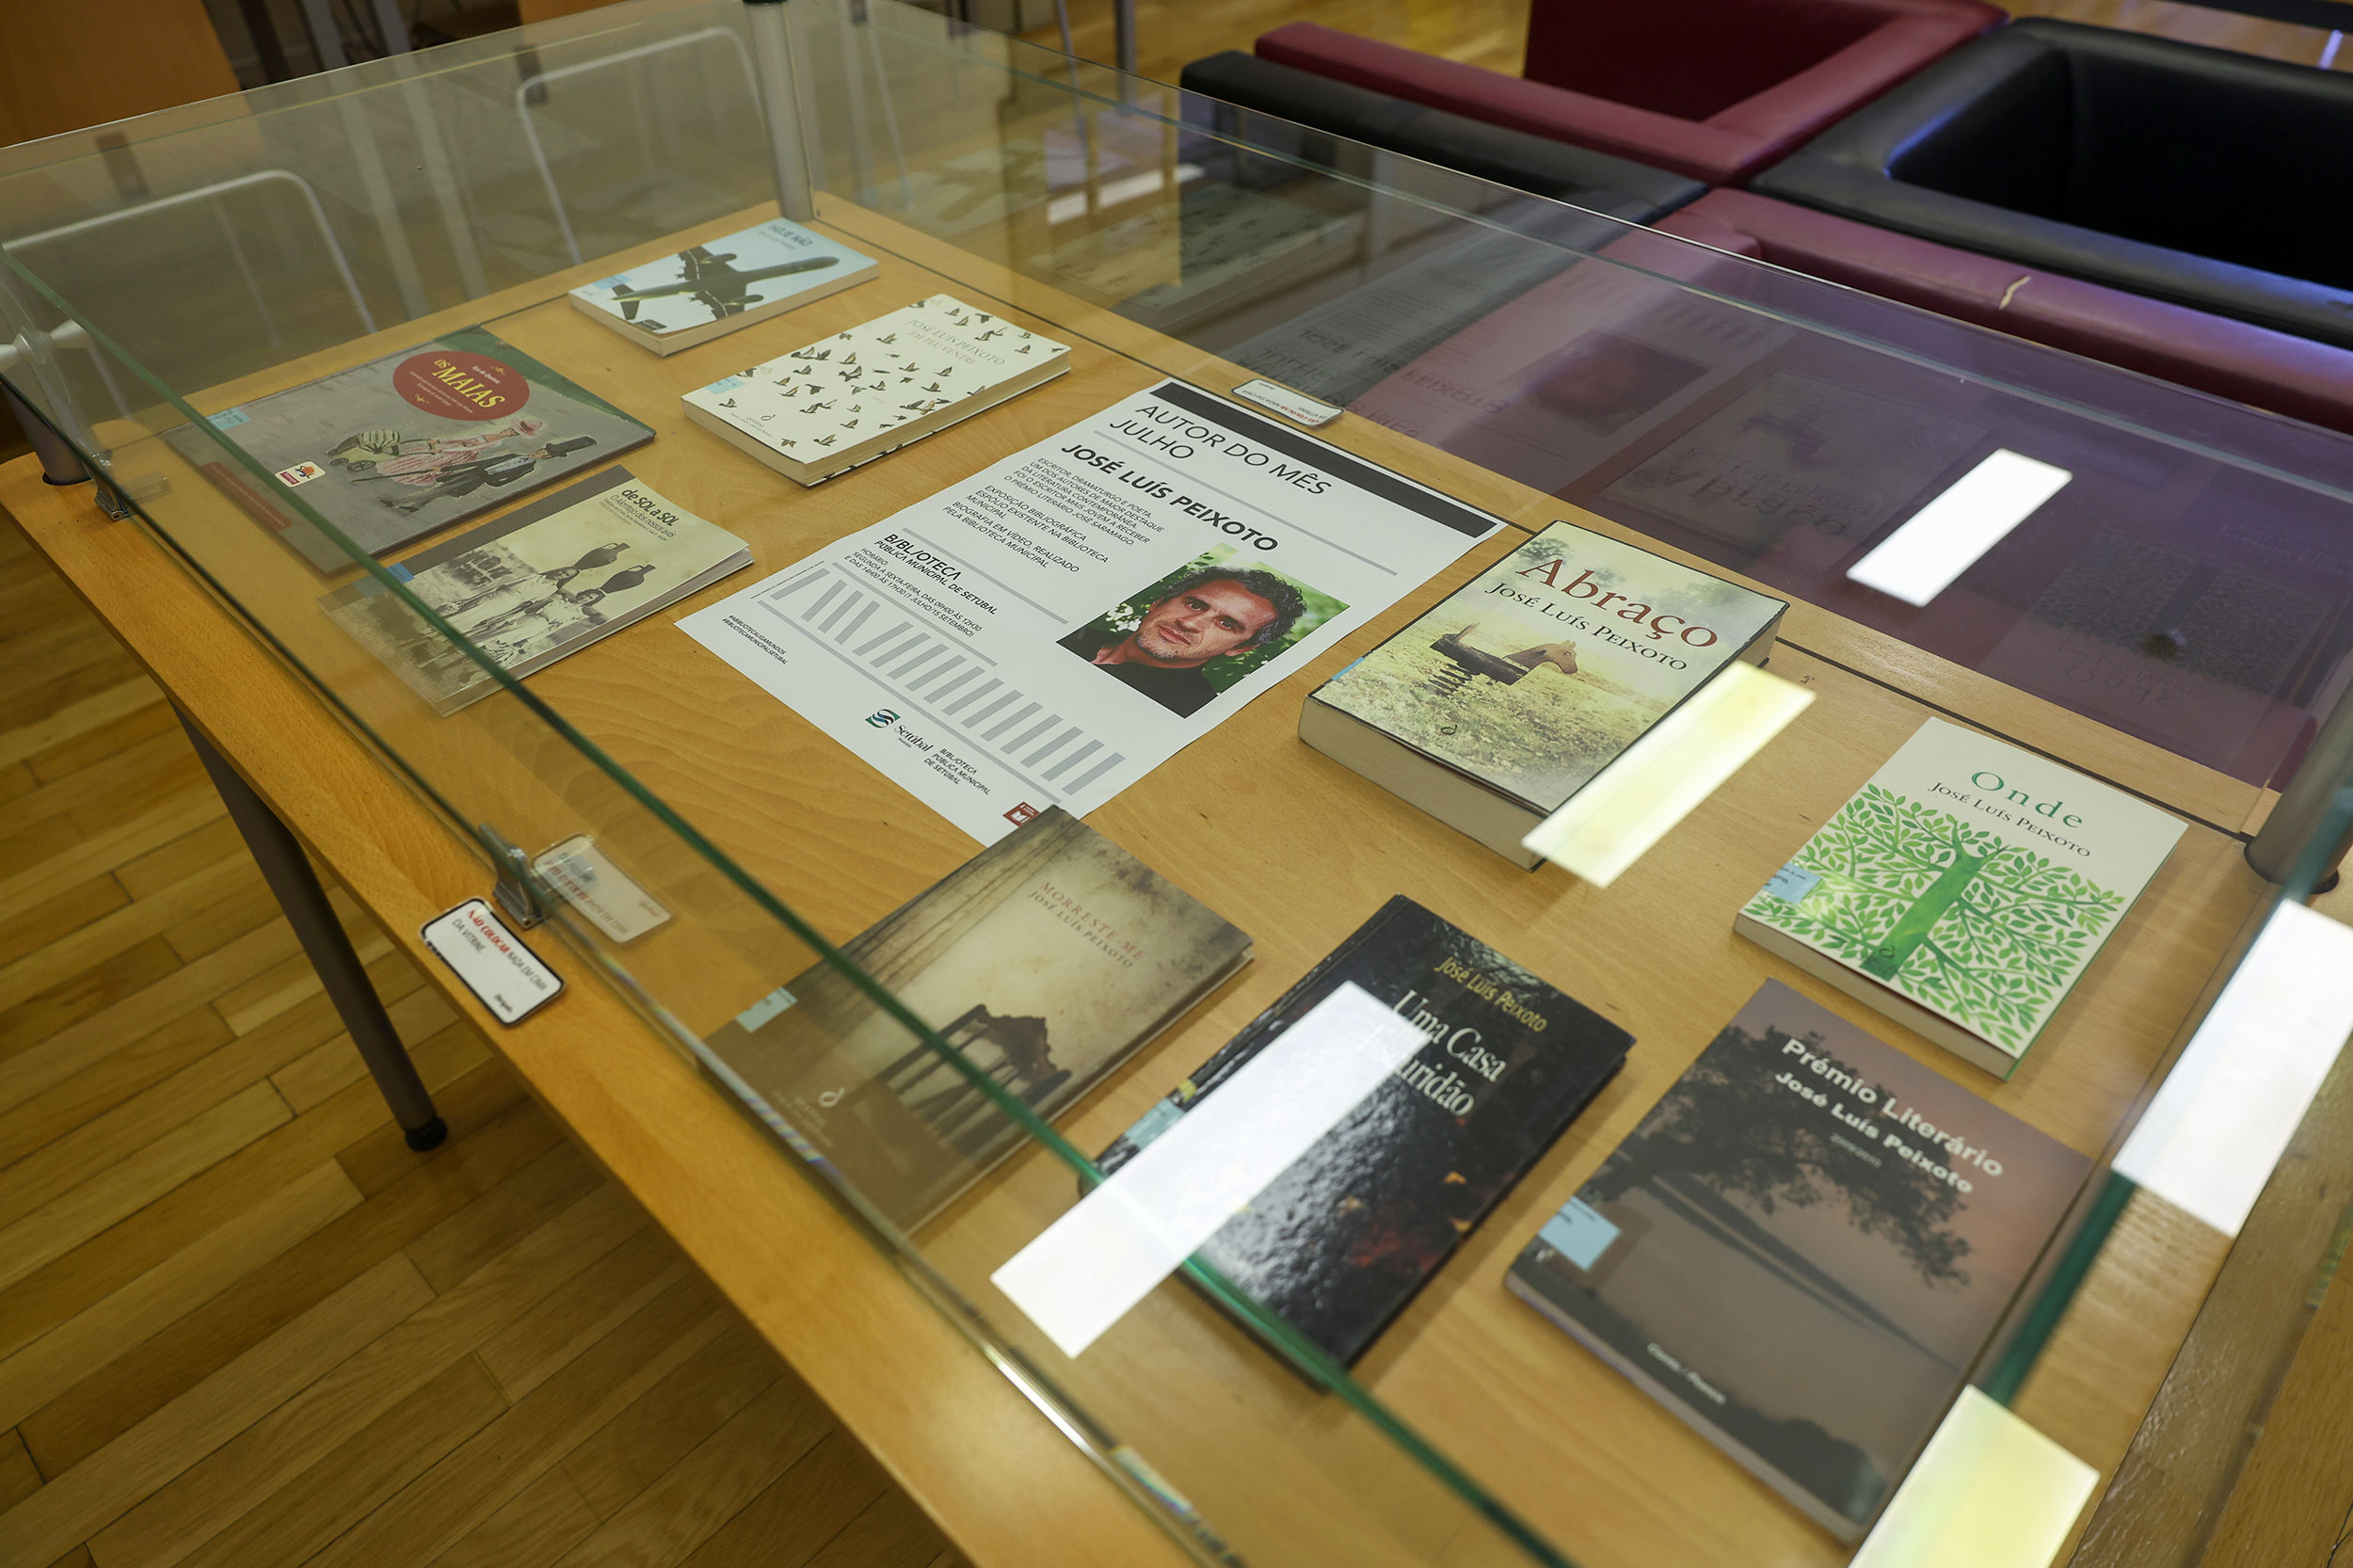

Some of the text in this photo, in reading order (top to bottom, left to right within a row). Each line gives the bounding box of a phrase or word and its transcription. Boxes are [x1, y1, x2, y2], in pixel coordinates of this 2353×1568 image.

[432, 365, 505, 408] MAIAS
[1110, 419, 1194, 459] JULHO
[1135, 406, 1332, 495] AUTOR DO MÊS
[621, 488, 680, 527] de SOL a SOL
[966, 494, 1010, 520] MUNICIPAL
[984, 485, 1087, 542] EXPOSIÇÃO BIBLIOGRÁFICA
[1011, 478, 1039, 495] PRÉMIO
[1037, 492, 1074, 514] LITERÁRIO
[1071, 511, 1091, 524] JOSÉ
[1013, 470, 1026, 478] FOI
[1032, 480, 1066, 501] ESCRITOR
[1065, 498, 1085, 510] MAIS
[1082, 508, 1112, 523] JOVEM
[1115, 523, 1151, 544] RECEBER
[1021, 465, 1034, 474] DA
[1032, 472, 1073, 495] LITERATURA
[1030, 461, 1165, 533] UM DOS AUTORES DE MAIOR DESTAQUE
[1061, 444, 1278, 552] JOSÉ LUÍS PEIXOTO
[1071, 475, 1122, 503] DRAMATURGO
[942, 506, 1049, 568] PELA BIBLIOTECA MUNICIPAL
[952, 501, 1080, 573] BIOGRAFIA EM VÍDEO, REALIZADO
[975, 489, 1110, 563] ESPÓLIO EXISTENTE NA BIBLIOTECA
[848, 558, 864, 568] DAS
[879, 576, 889, 584] ÀS
[887, 581, 907, 596] 17H30
[938, 612, 975, 638] SETEMBRO)
[852, 552, 882, 571] SEGUNDA
[920, 592, 936, 604] DAS
[952, 611, 964, 621] ÀS
[961, 618, 983, 632] 12H30
[905, 558, 948, 585] MUNICIPAL
[947, 583, 963, 594] DE
[1514, 558, 1719, 648] Abraço
[1484, 583, 1688, 671] JOSÉ LUÍS PEIXOTO
[894, 725, 935, 753] Setúbal
[923, 758, 936, 768] DE
[956, 771, 991, 794] MUNICIPAL
[1971, 771, 2083, 829] Onde
[1928, 782, 2091, 857] JOSÉ LUÍS PEIXOTO
[452, 919, 466, 933] DA
[1040, 881, 1144, 960] MORRESTE-ME
[1083, 930, 1133, 968] PEIXOTO
[479, 922, 510, 954] COLOCAR
[506, 950, 526, 971] NADA
[520, 964, 534, 979] EM
[529, 972, 549, 992] CIMA
[1433, 955, 1548, 1033] José Luís Peixoto
[1393, 989, 1507, 1082] Uma Casa
[1774, 1072, 1974, 1194] José Luís Peixoto
[1781, 1038, 2004, 1177] Prémio Literário
